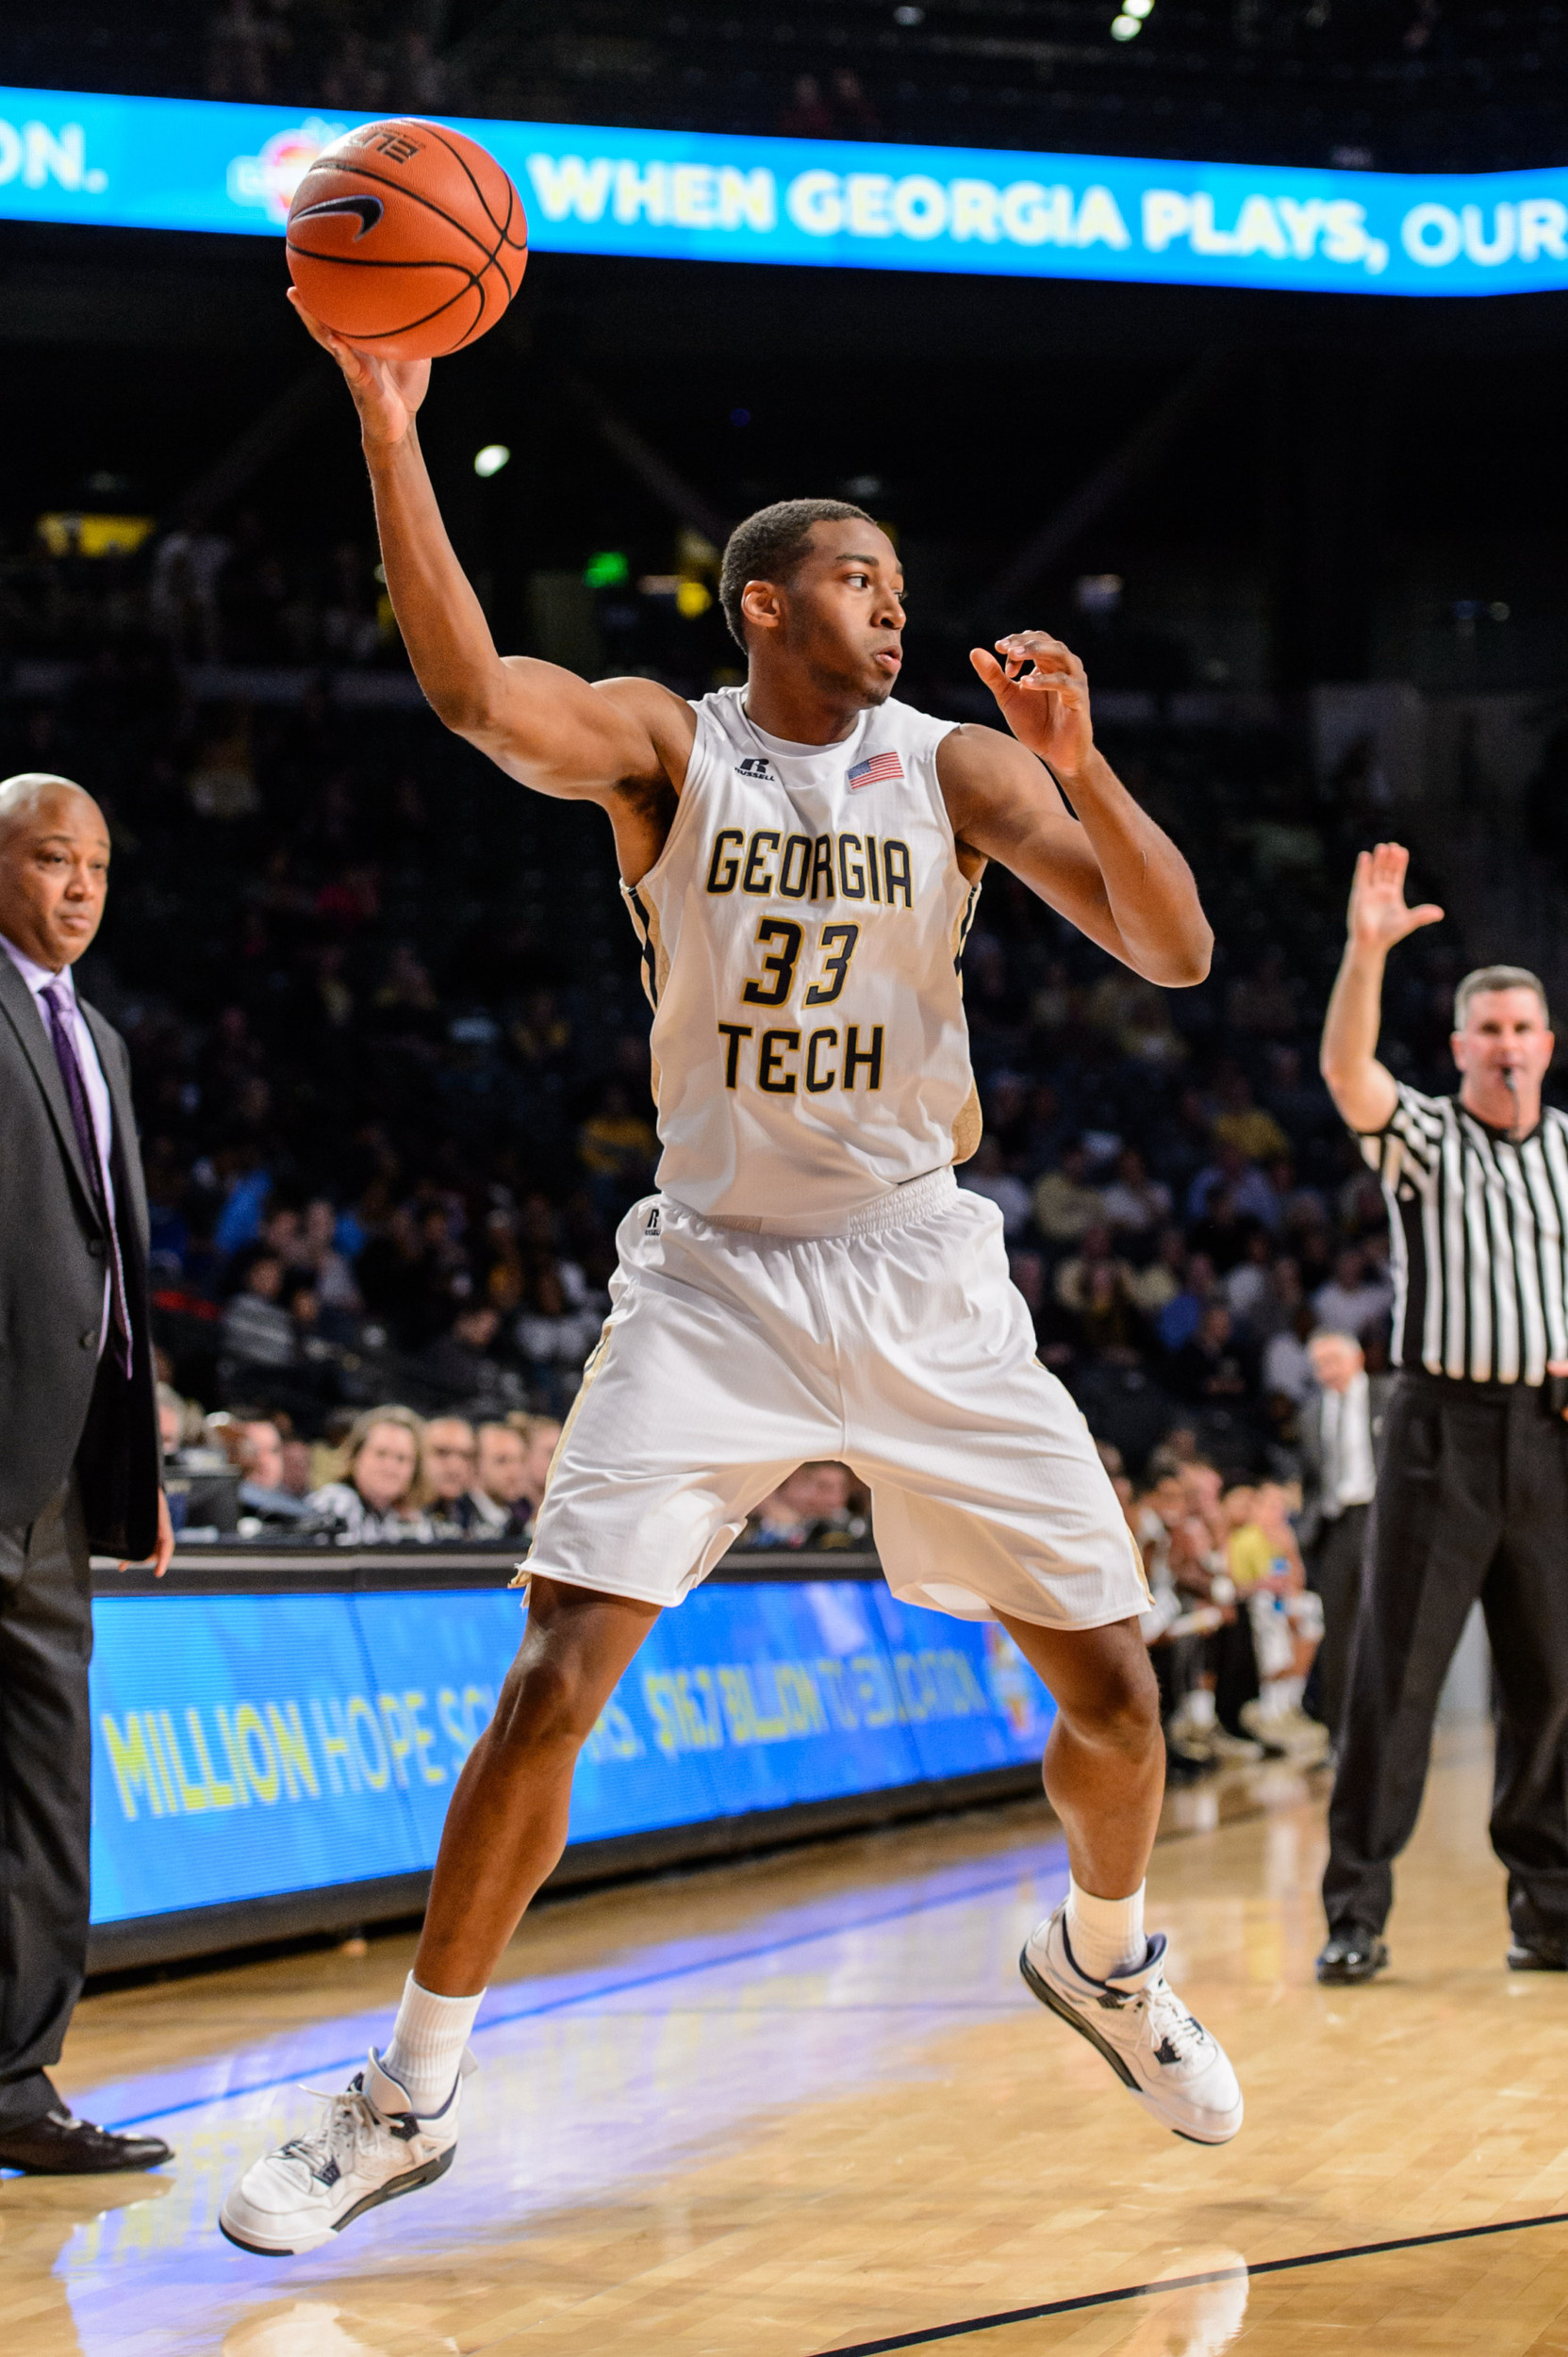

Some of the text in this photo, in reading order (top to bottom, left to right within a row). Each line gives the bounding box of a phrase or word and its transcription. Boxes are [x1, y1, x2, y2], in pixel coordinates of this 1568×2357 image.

[525, 152, 1568, 275] WHEN GEORGIA PLAYS, OUR
[734, 766, 775, 782] RUSSELL
[705, 827, 915, 910] GEORGIA
[740, 915, 861, 1010] 33
[718, 1021, 884, 1096] TECH
[100, 1701, 322, 1821] MILLION
[308, 1690, 446, 1795] HOPE
